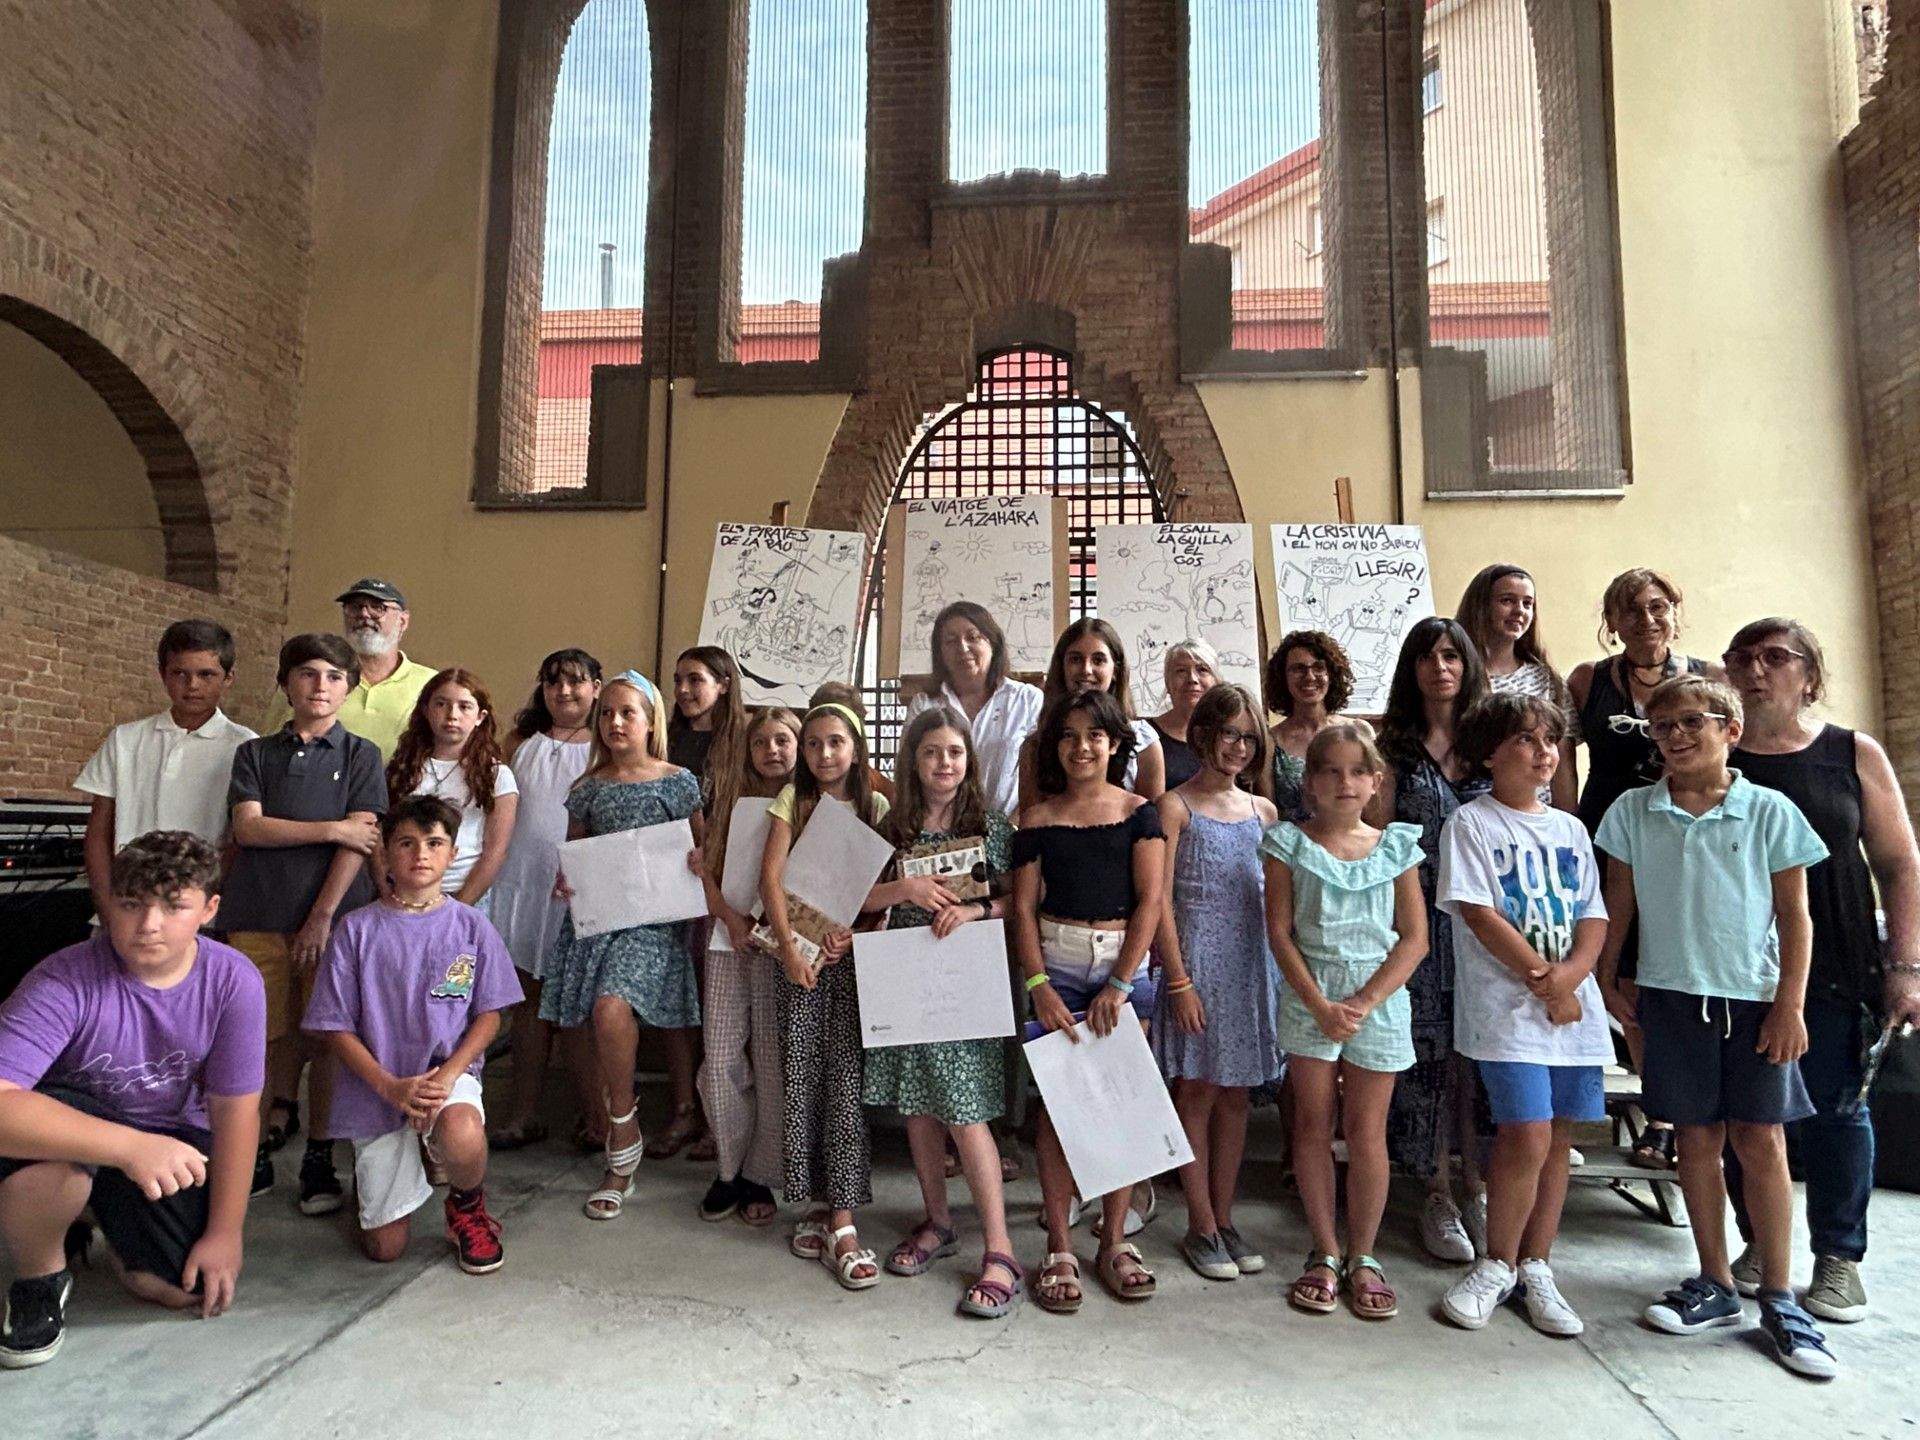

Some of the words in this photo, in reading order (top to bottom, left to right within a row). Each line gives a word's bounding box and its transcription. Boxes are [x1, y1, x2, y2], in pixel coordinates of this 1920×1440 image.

[908, 502, 926, 513] EL
[931, 497, 989, 515] VIATGE
[998, 496, 1024, 508] DE
[945, 510, 1039, 527] L'AZAHARA
[720, 523, 745, 534] ELS
[749, 526, 809, 542] PIRATES
[1160, 524, 1180, 534] EL
[1180, 524, 1219, 534] GALL
[1286, 524, 1311, 541] LA
[1312, 524, 1390, 541] CRISTINA
[721, 535, 741, 546] DE
[742, 537, 759, 548] LA
[1157, 533, 1176, 546] LA
[1178, 533, 1233, 545] GUILLA
[1291, 540, 1310, 549] EL
[1361, 540, 1378, 551] NO
[1184, 545, 1203, 556] EL
[1174, 555, 1204, 567] GOS
[1405, 587, 1420, 604] ?
